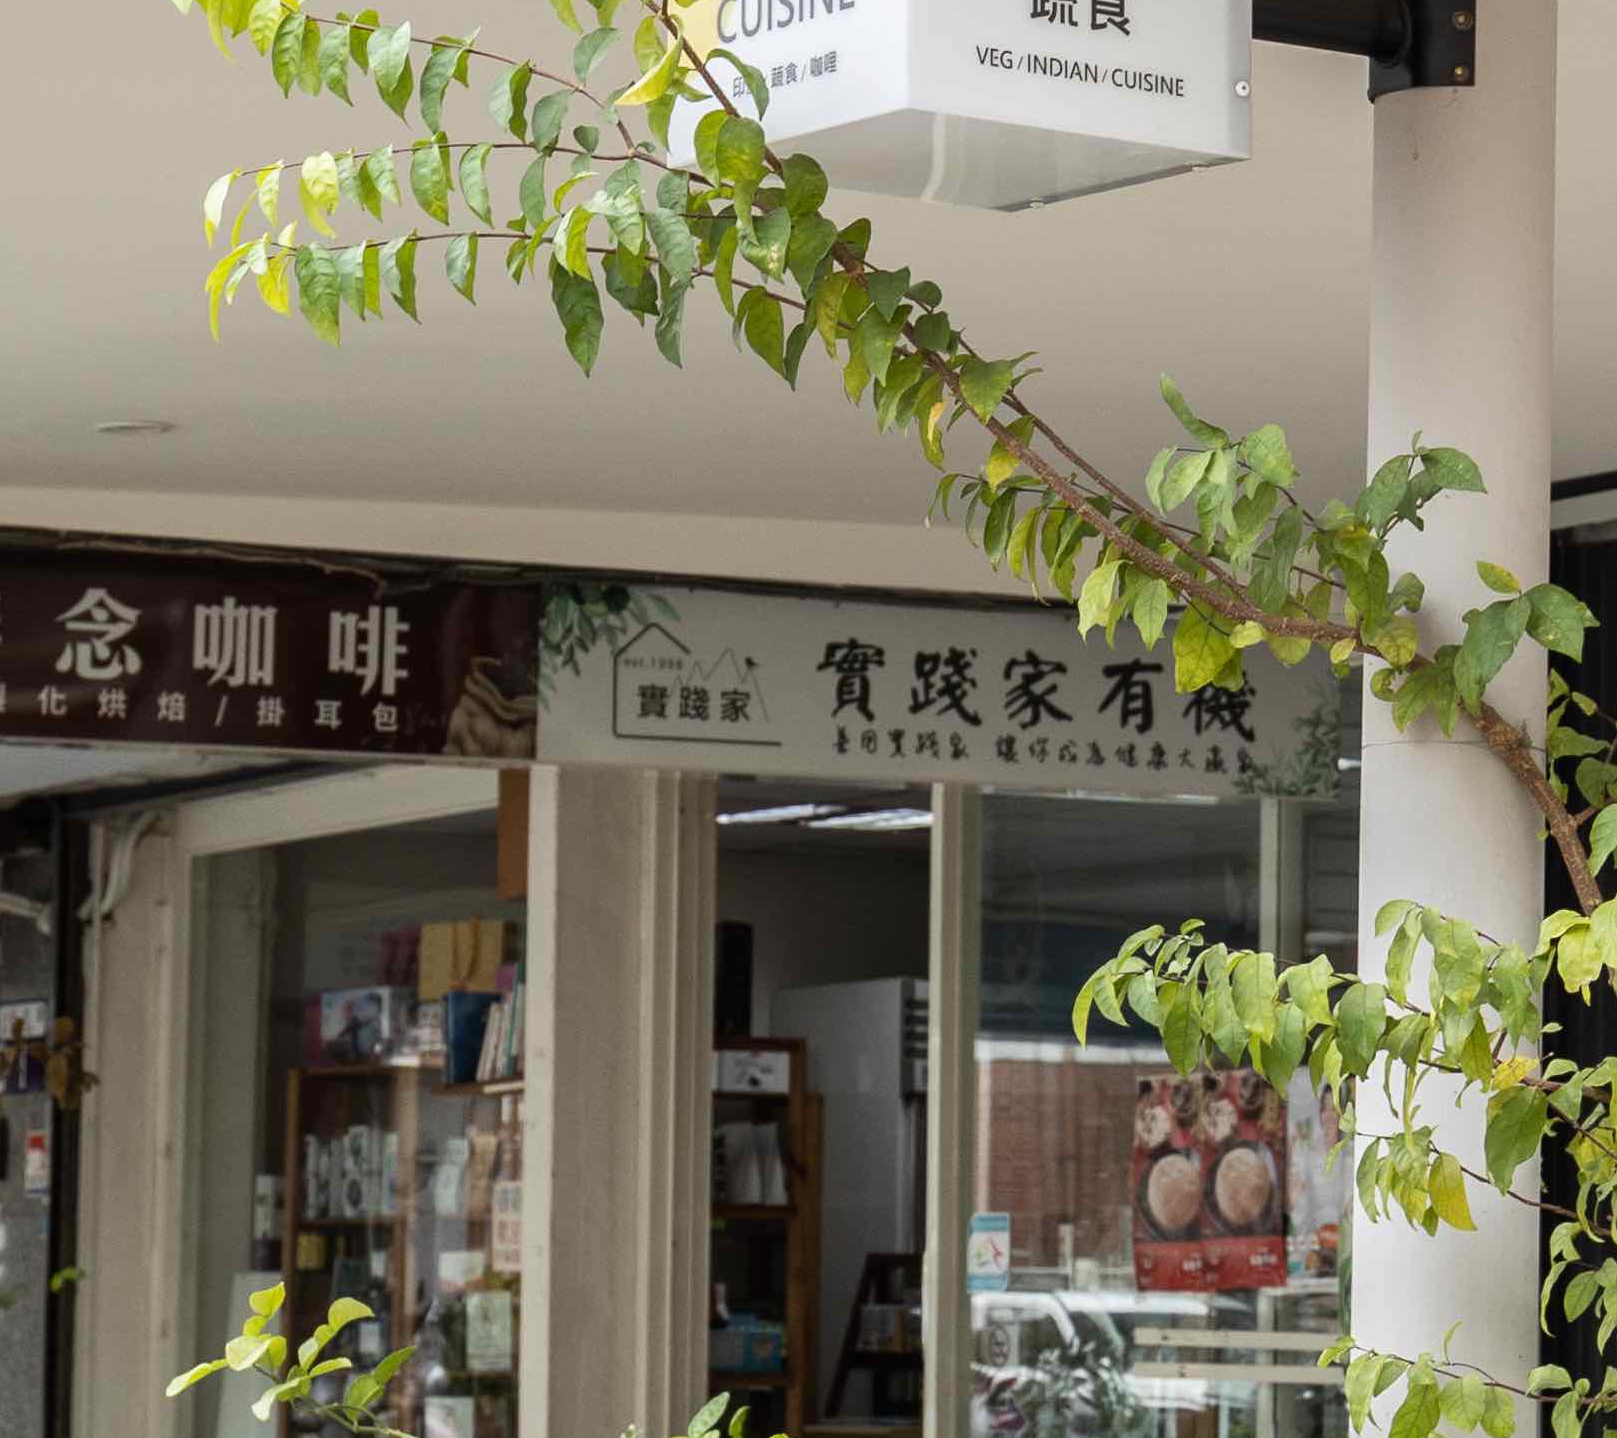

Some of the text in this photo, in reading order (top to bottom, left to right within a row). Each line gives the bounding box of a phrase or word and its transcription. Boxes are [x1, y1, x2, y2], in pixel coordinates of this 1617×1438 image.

[771, 62, 798, 89] 蔬食
[976, 45, 1013, 70] VEG
[1027, 53, 1099, 84] INDIAN
[1111, 68, 1184, 98] CUISINE
